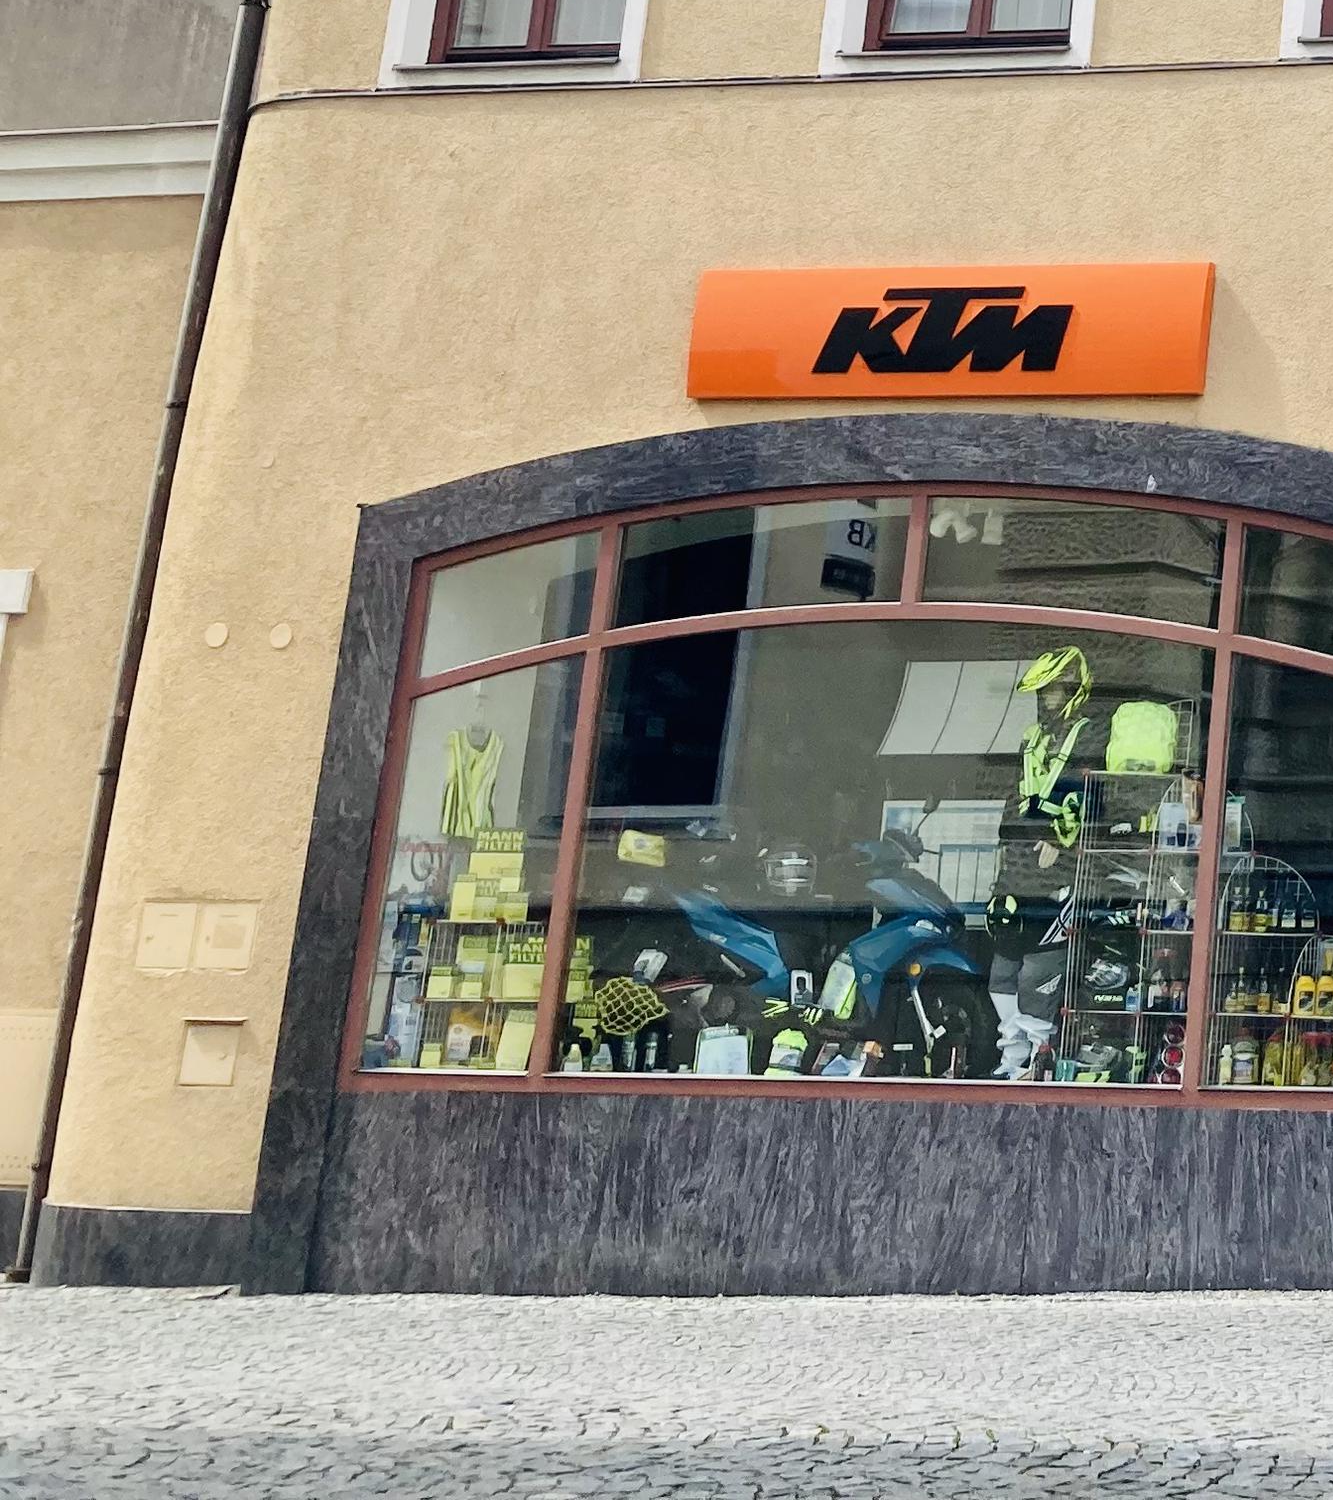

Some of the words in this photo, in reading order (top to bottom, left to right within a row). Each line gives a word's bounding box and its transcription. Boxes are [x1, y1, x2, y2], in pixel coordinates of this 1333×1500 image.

[812, 286, 1073, 374] KTM
[478, 831, 524, 841] MANN
[476, 841, 522, 851] FILTER
[510, 943, 547, 952] MAN
[509, 953, 545, 963] FILTE
